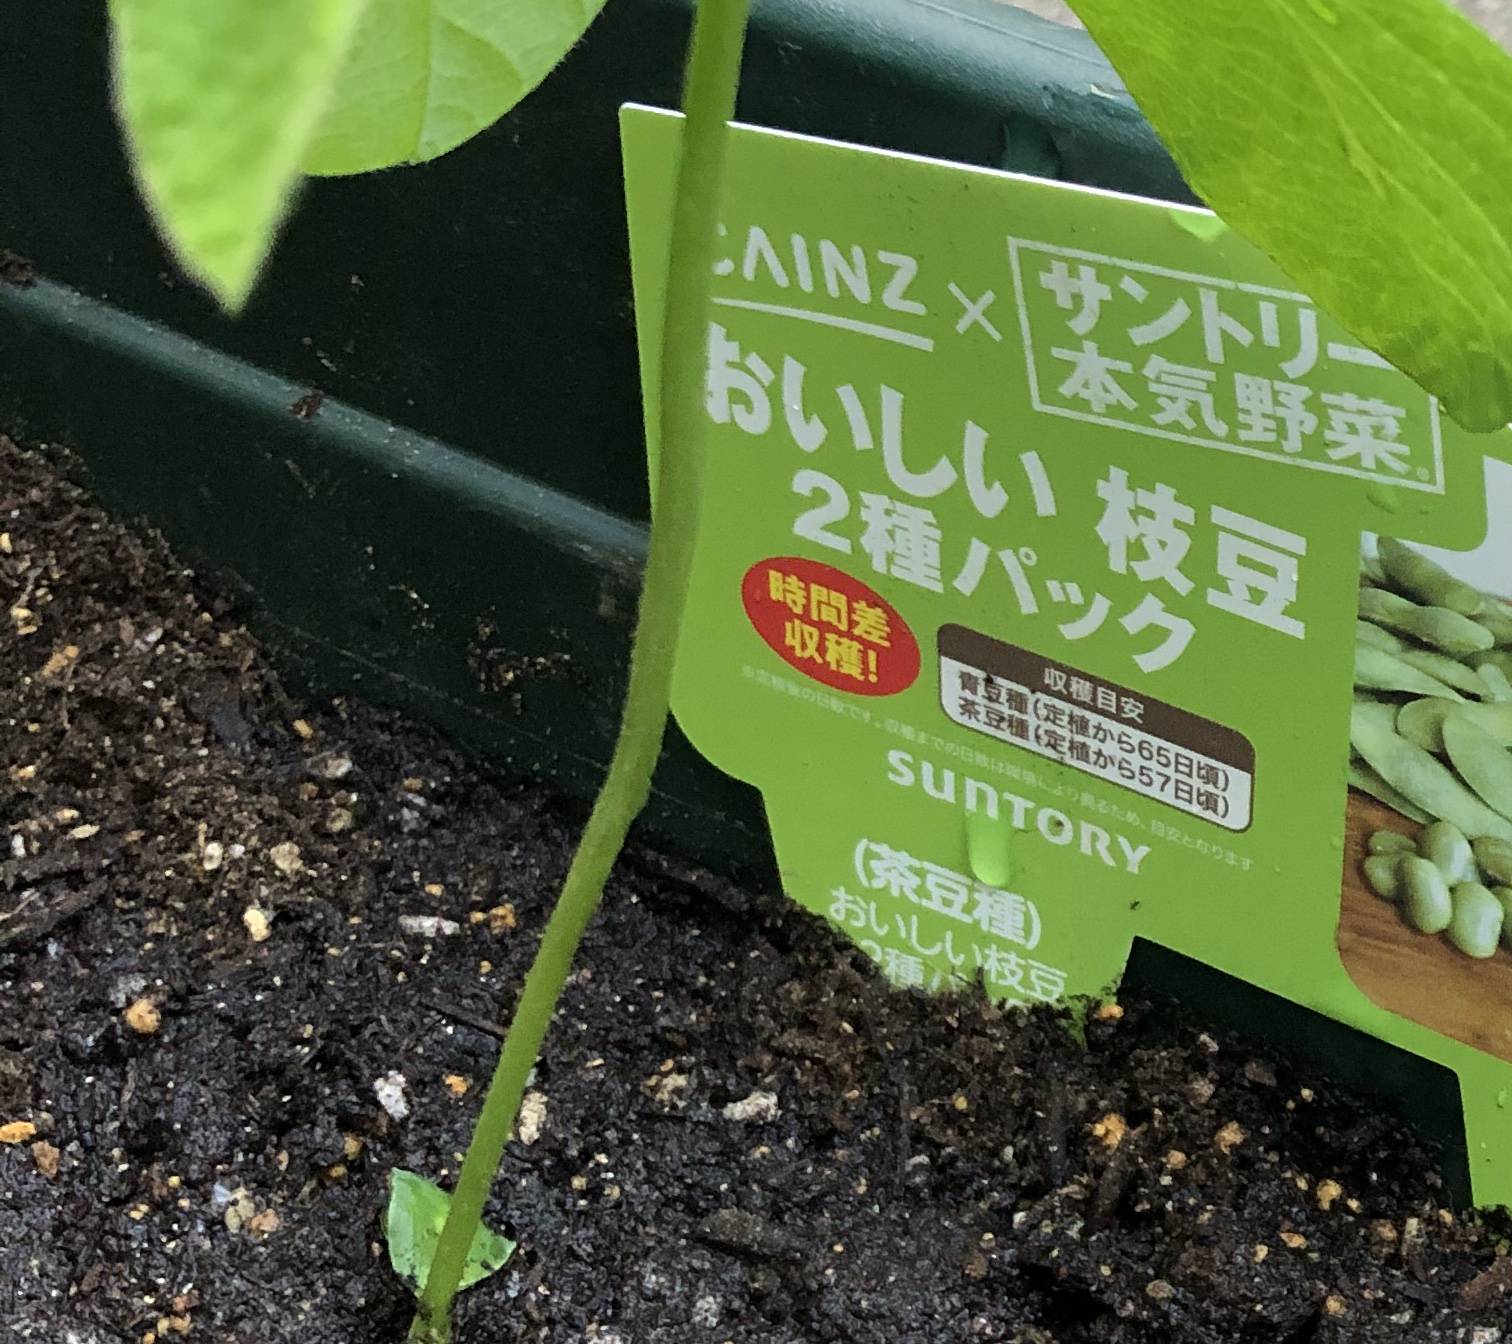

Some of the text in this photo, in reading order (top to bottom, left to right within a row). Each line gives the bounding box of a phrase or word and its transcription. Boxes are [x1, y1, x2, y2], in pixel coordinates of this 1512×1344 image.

[1039, 260, 1396, 379] サントリー
[1050, 340, 1412, 474] 本気野菜
[767, 569, 891, 648] 時間差
[791, 469, 1197, 674] 2種パック
[1043, 667, 1145, 724] 収穫目安
[887, 749, 1152, 875] SUNTORY
[828, 885, 1068, 1003] おいしい枝豆
[854, 837, 1042, 950] (茶豆種)
